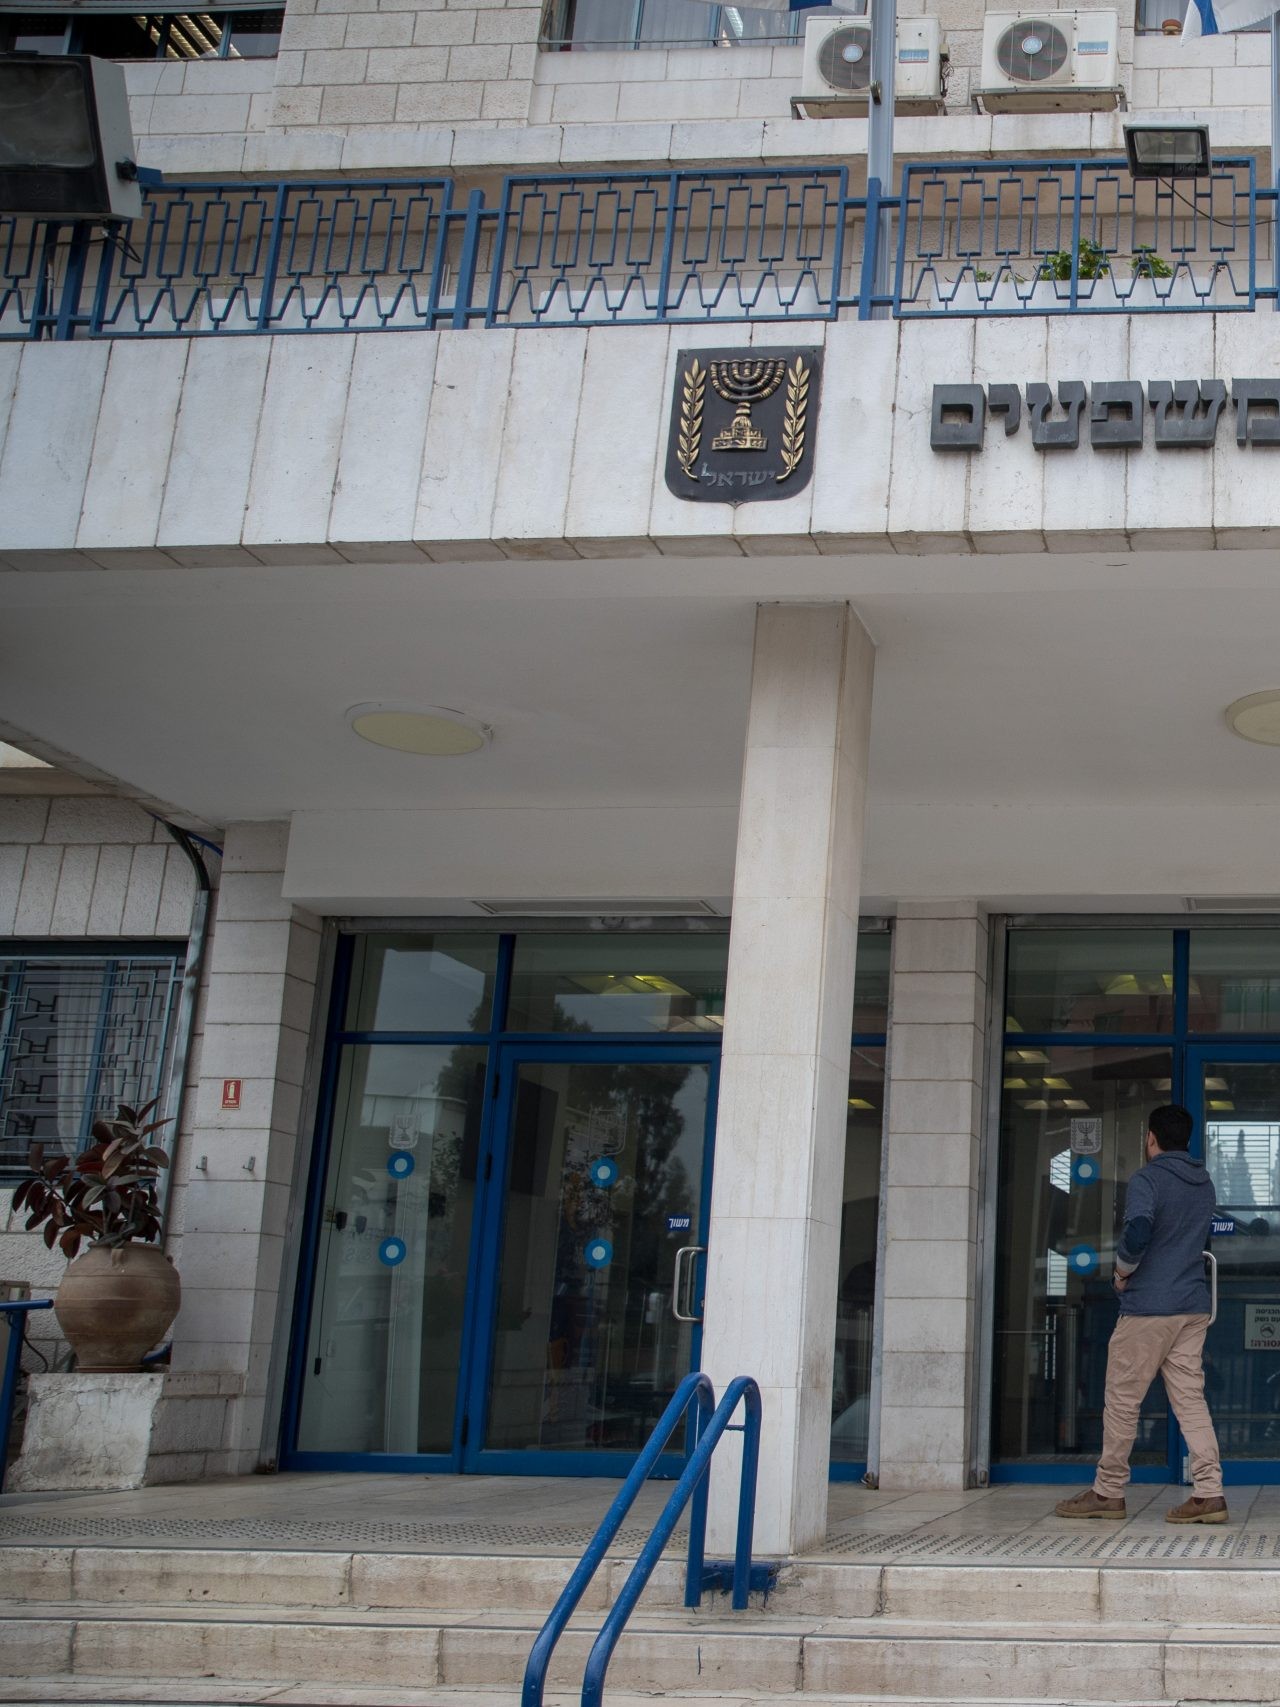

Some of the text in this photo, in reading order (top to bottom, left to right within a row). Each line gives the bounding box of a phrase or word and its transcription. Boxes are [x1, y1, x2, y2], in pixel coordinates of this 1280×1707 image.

[700, 461, 777, 487] ישראל
[668, 1218, 690, 1229] משוך
[1211, 1221, 1234, 1232] משוך
